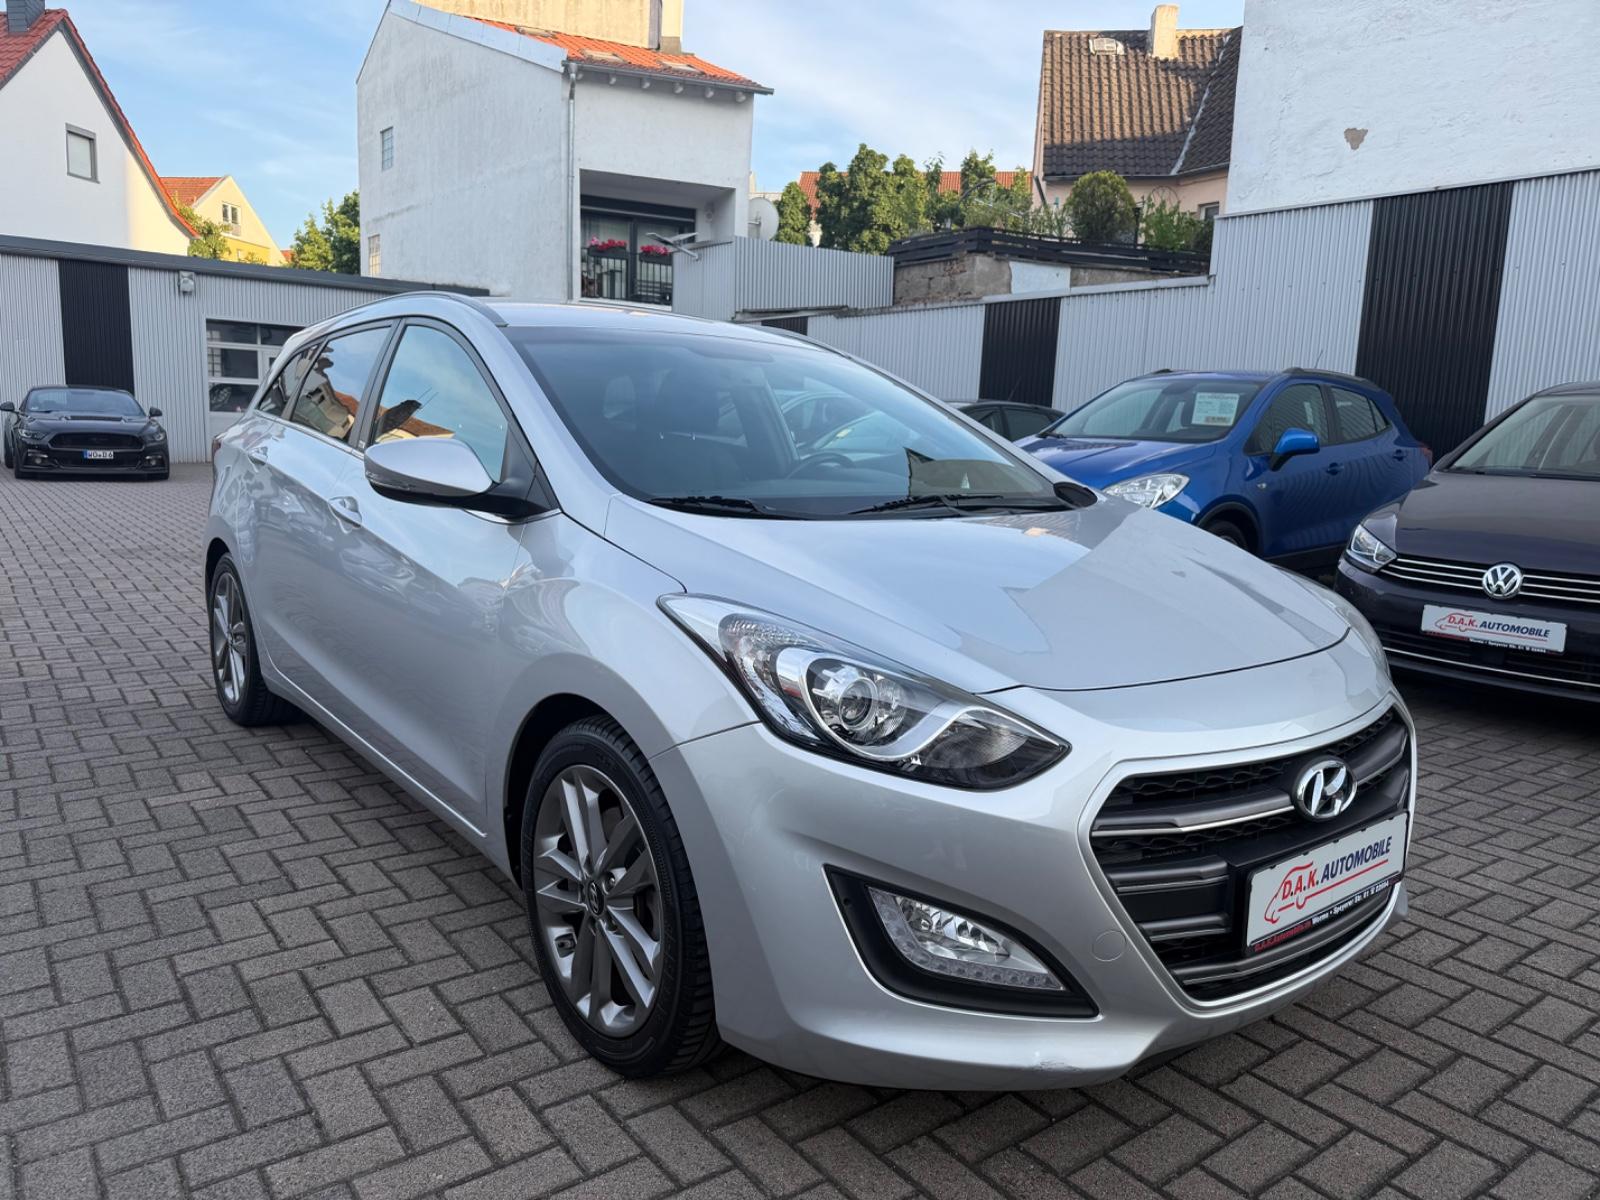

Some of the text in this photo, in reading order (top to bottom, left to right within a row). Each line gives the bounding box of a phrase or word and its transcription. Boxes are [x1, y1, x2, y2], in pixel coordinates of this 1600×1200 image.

[1447, 614, 1478, 628] D.A.K.
[1479, 620, 1551, 638] AUTOMOBILE
[1281, 836, 1392, 901] D.A.K. AUTOMOBILE
